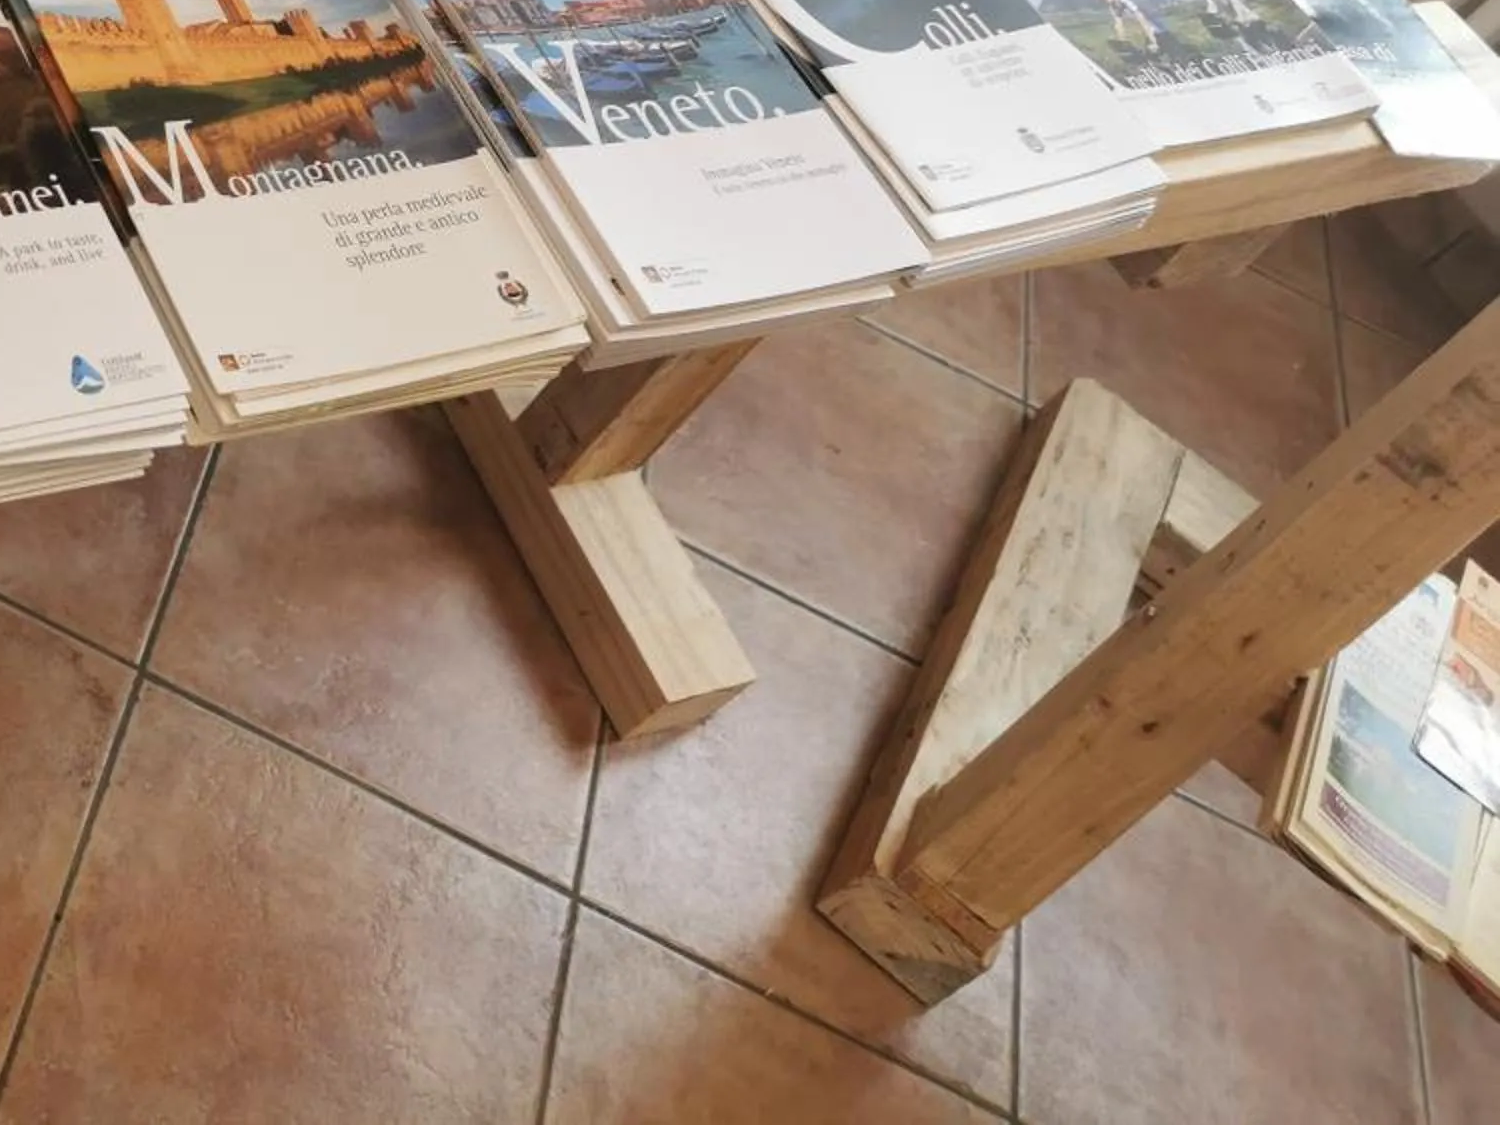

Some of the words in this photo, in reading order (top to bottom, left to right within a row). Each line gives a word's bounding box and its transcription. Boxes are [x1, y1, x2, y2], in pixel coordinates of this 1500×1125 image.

[90, 119, 423, 207] Montagnana.
[321, 210, 360, 228] Una
[362, 202, 404, 225] perla
[405, 185, 489, 214] medievale
[335, 232, 353, 249] di
[356, 221, 413, 247] grande
[430, 209, 480, 231] antico
[0, 245, 10, 260] A
[13, 239, 45, 259] park
[48, 238, 62, 250] to
[51, 251, 76, 268] and
[345, 242, 428, 272] splendore
